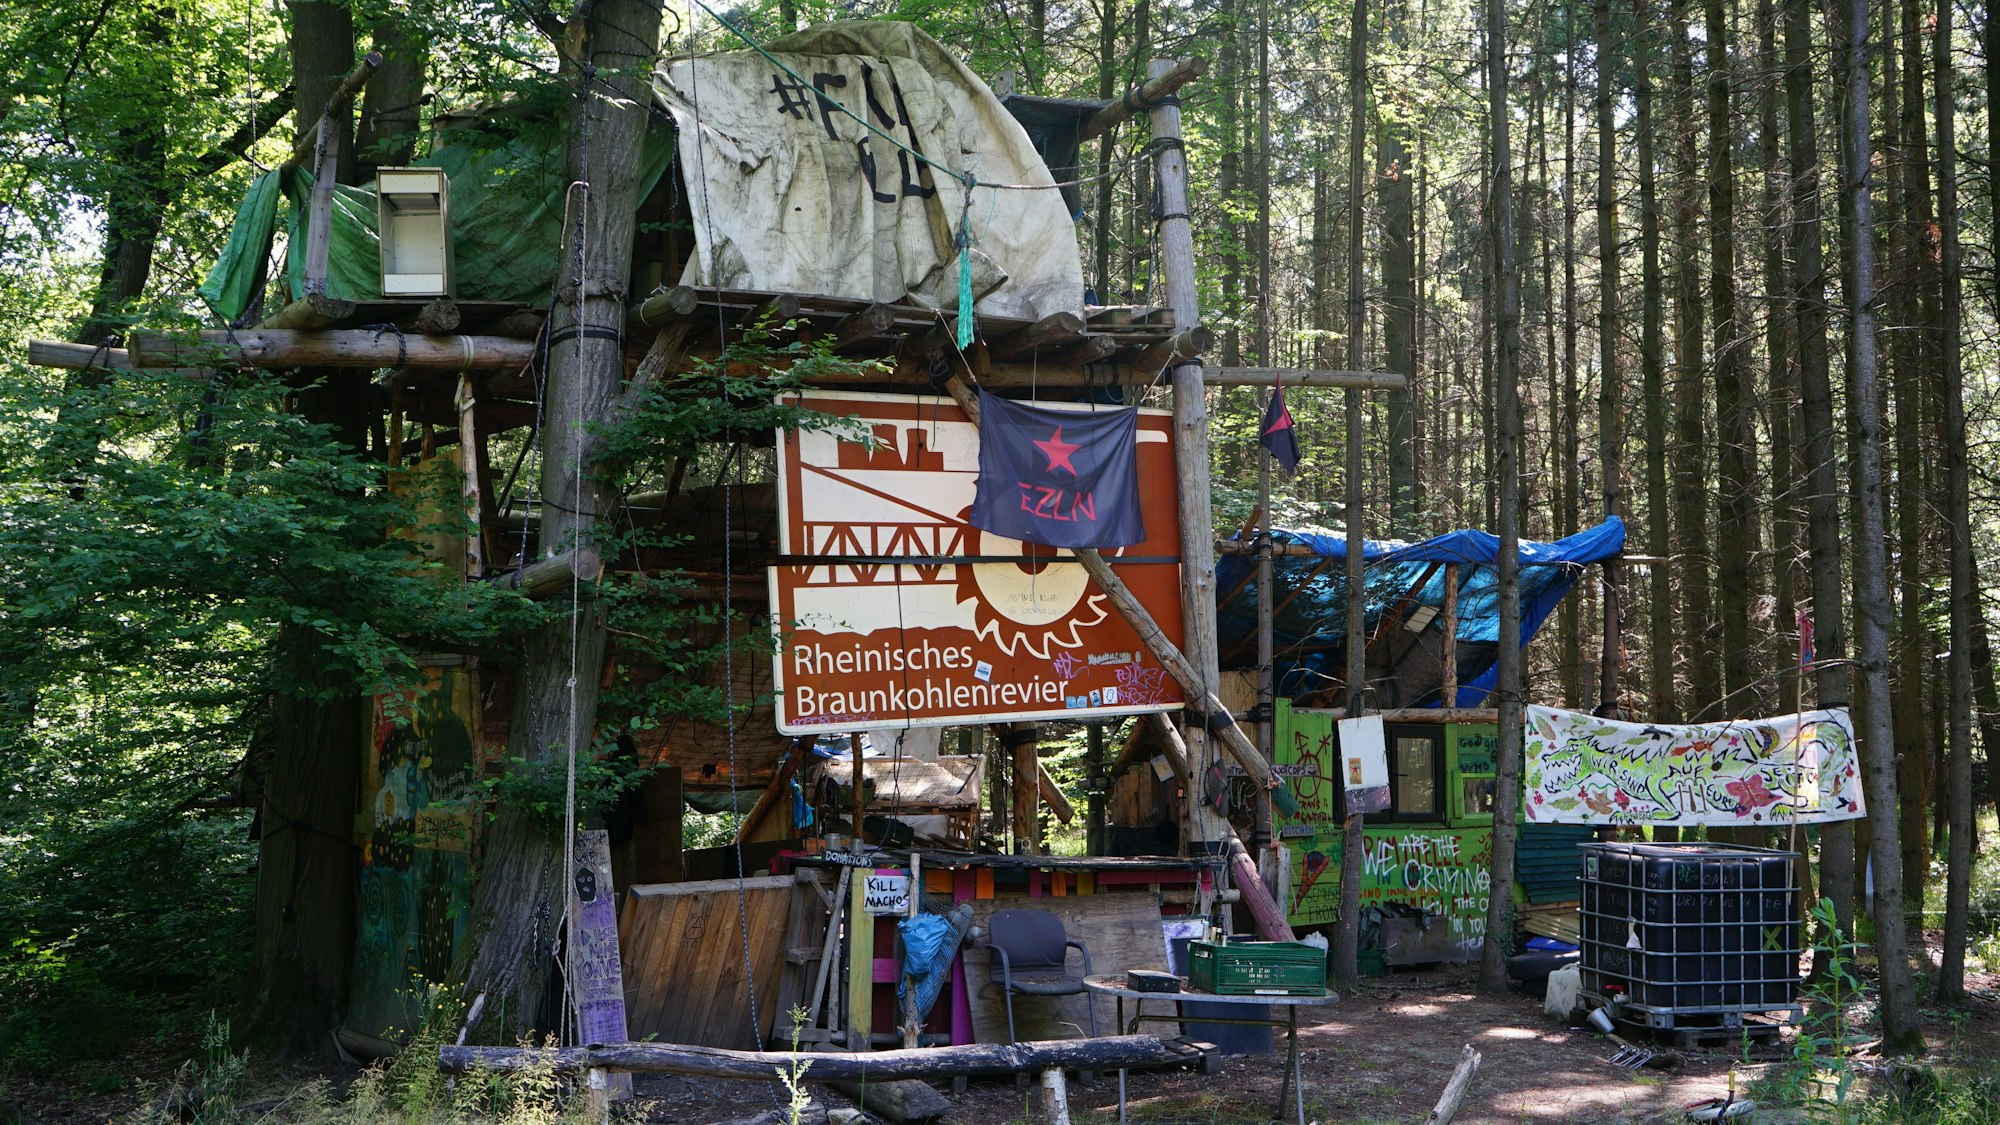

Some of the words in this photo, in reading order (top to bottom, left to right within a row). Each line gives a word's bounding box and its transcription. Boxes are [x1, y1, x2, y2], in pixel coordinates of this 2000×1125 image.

[1018, 481, 1096, 522] EZLN
[794, 638, 974, 676] Rheinisches
[797, 675, 1069, 717] Braunkohlenrevier
[1592, 754, 1618, 775] WIR
[1620, 770, 1646, 793] SIND
[1665, 764, 1705, 779] AUF
[1284, 825, 1314, 834] KITCHEN
[825, 851, 872, 867] DONATIONS
[1362, 840, 1398, 876] WE
[1399, 833, 1430, 855] ARE
[1432, 834, 1460, 857] THE
[1405, 859, 1491, 895] CRIMINA
[865, 894, 909, 908] MACHOS
[1309, 904, 1341, 922] FRON
[1468, 917, 1488, 934] YOU
